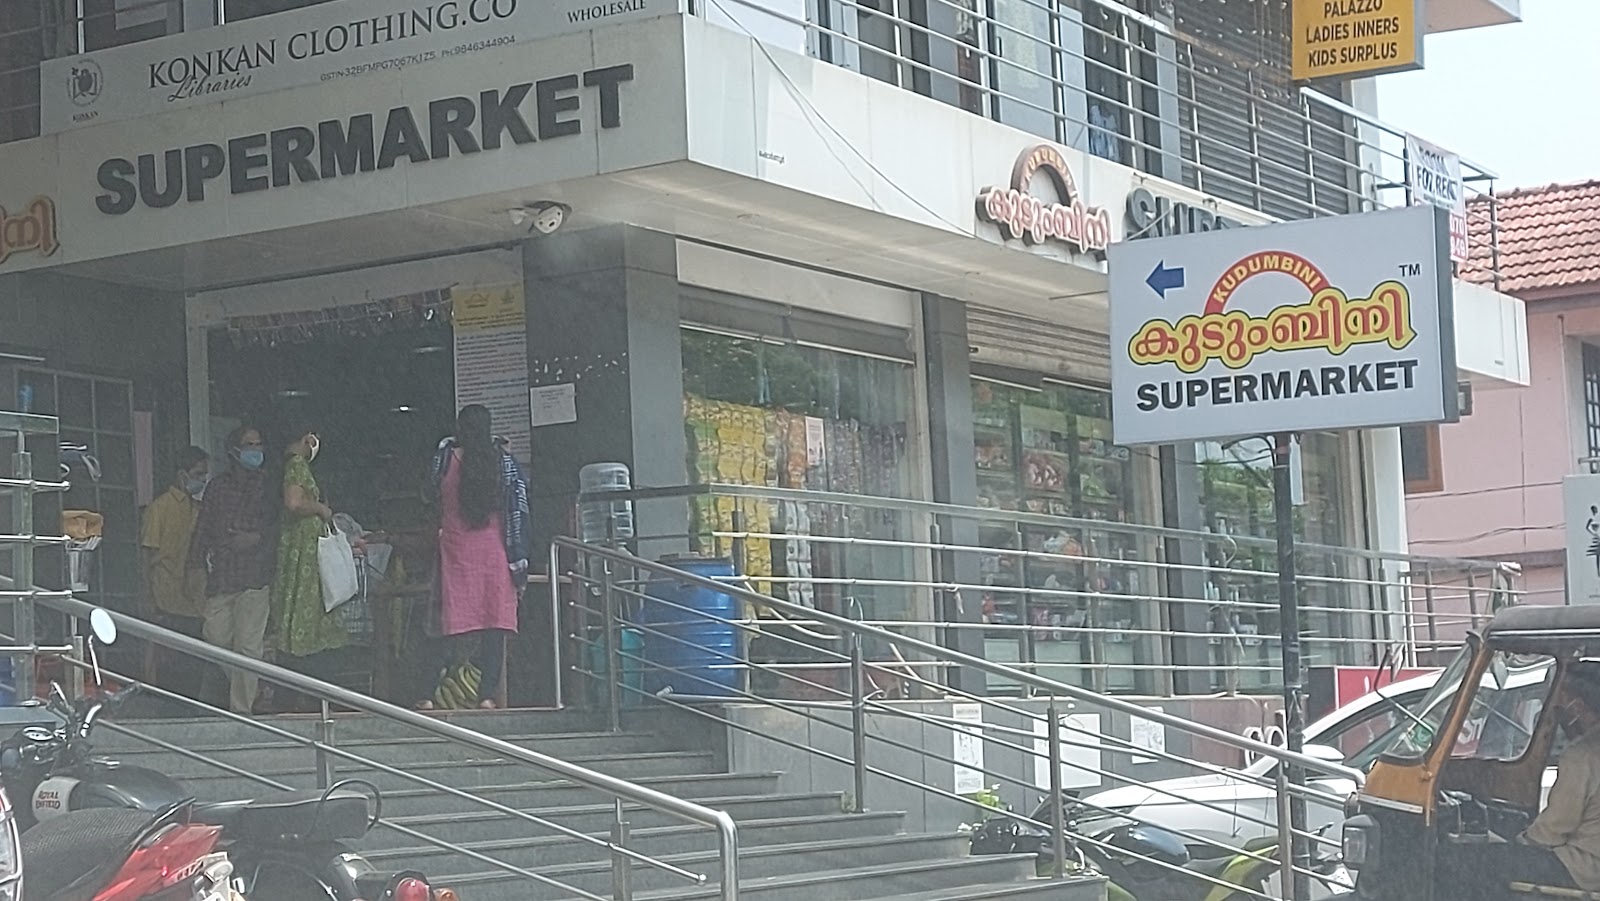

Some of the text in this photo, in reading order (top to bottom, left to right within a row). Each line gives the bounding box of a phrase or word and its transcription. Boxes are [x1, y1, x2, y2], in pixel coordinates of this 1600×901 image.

[567, 0, 646, 23] WHOLESALE
[1324, 0, 1383, 19] PALAZZO
[149, 0, 517, 89] KONKAN CLOTHING.CO
[1306, 16, 1399, 44] LADIES INNERS
[1308, 42, 1398, 68] KIDS SURPLUS
[167, 72, 252, 102] Libraries
[96, 63, 634, 215] SUPERMARKET
[985, 188, 1111, 253] കുടുംബിനി
[1214, 254, 1322, 303] KUDUMBINI
[1399, 264, 1421, 277] TM
[1131, 284, 1409, 369] കുടുംബിനി
[1136, 359, 1419, 411] SUPERMARKET
